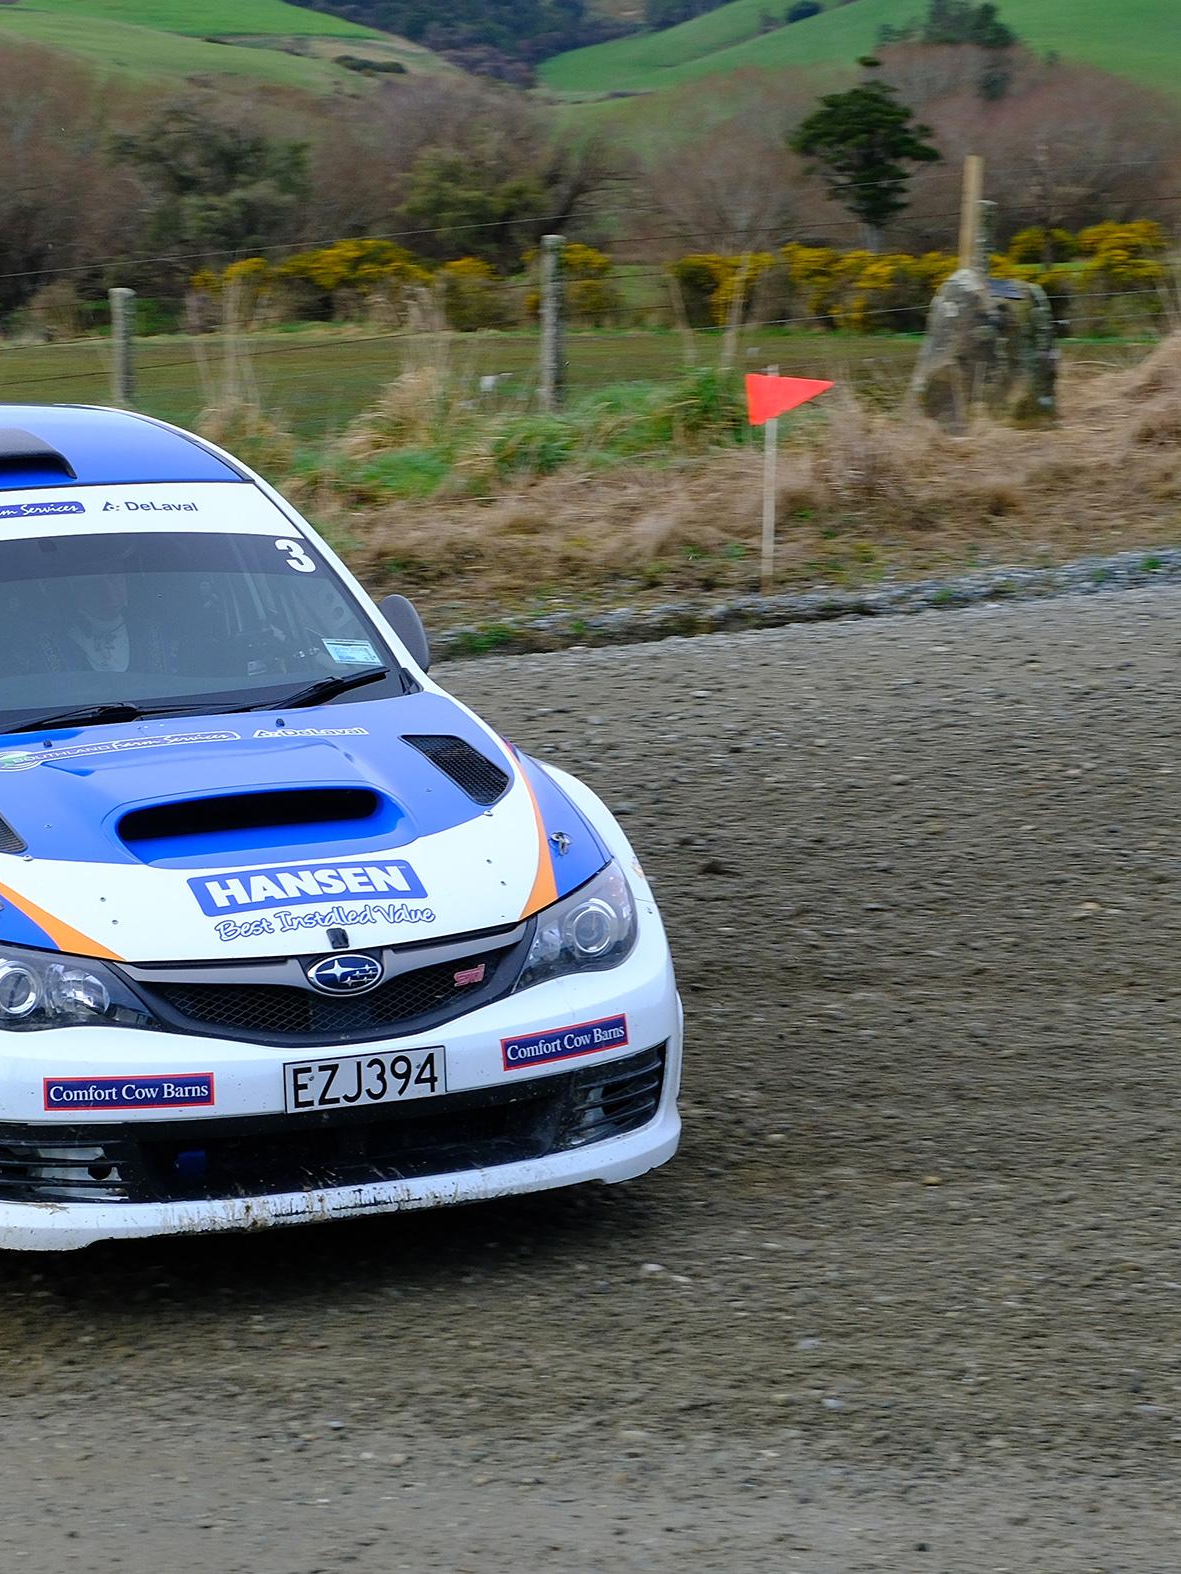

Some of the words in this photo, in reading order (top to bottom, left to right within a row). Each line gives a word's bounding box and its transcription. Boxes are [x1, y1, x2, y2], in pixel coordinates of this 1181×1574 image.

[20, 504, 79, 516] Services
[124, 501, 199, 512] DeLaval
[274, 539, 316, 573] 3
[204, 866, 412, 908] HANSEN
[214, 918, 274, 942] Best
[274, 905, 375, 932] Installed
[374, 903, 436, 923] Value
[506, 1039, 562, 1061] Comfort
[563, 1033, 592, 1050] Cow
[592, 1026, 625, 1043] Barns
[49, 1085, 118, 1102] Comfort
[121, 1084, 159, 1100] Cow
[162, 1083, 209, 1098] Barns
[292, 1052, 438, 1109] EZJ394
